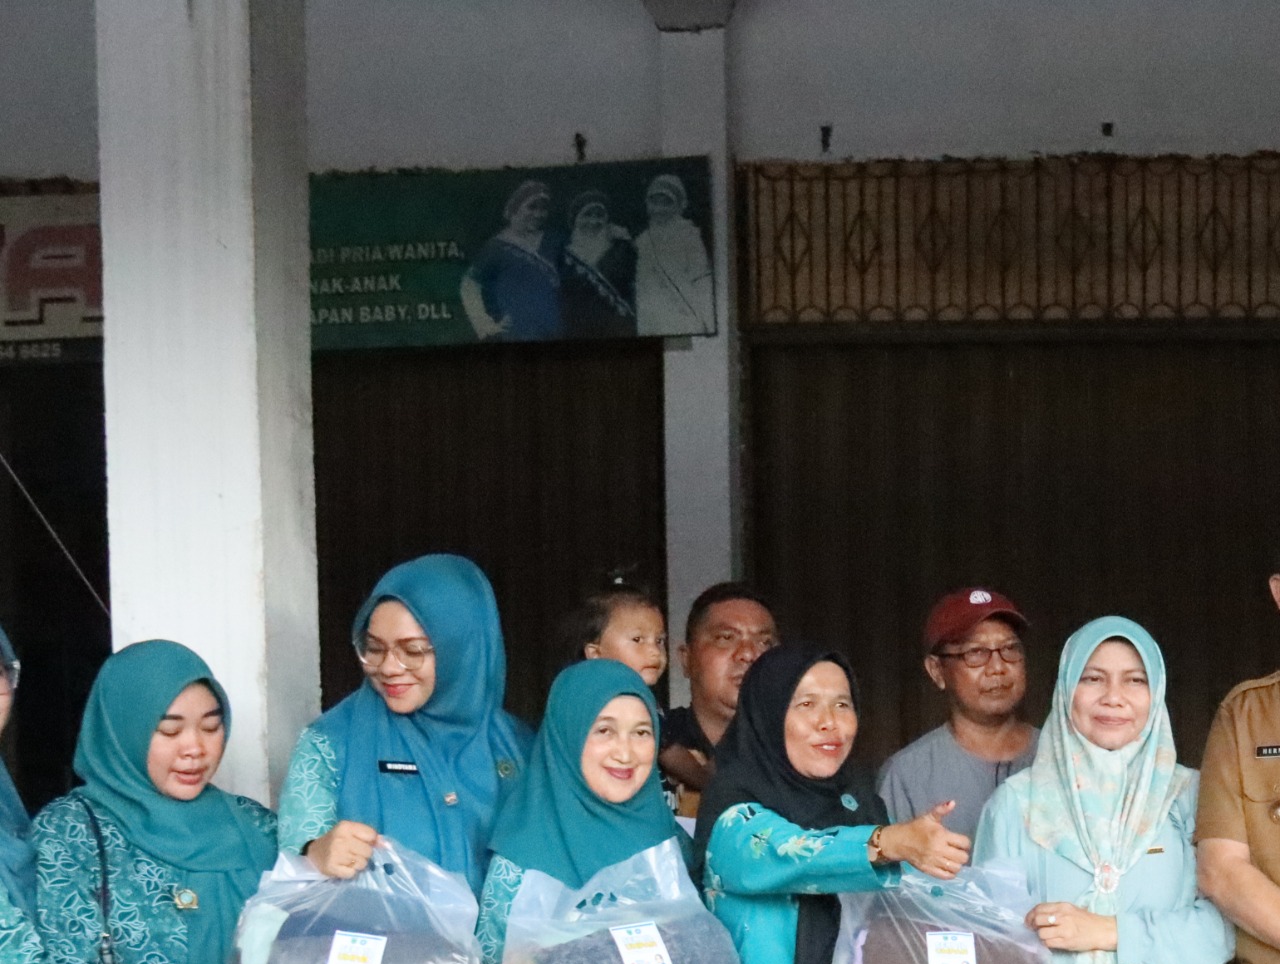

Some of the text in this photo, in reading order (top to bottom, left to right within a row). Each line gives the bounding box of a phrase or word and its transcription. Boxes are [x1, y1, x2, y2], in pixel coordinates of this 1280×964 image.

[340, 245, 383, 263] PRIA
[387, 241, 465, 261] WANITA,
[359, 304, 412, 324] BABY,
[417, 302, 451, 320] DLL
